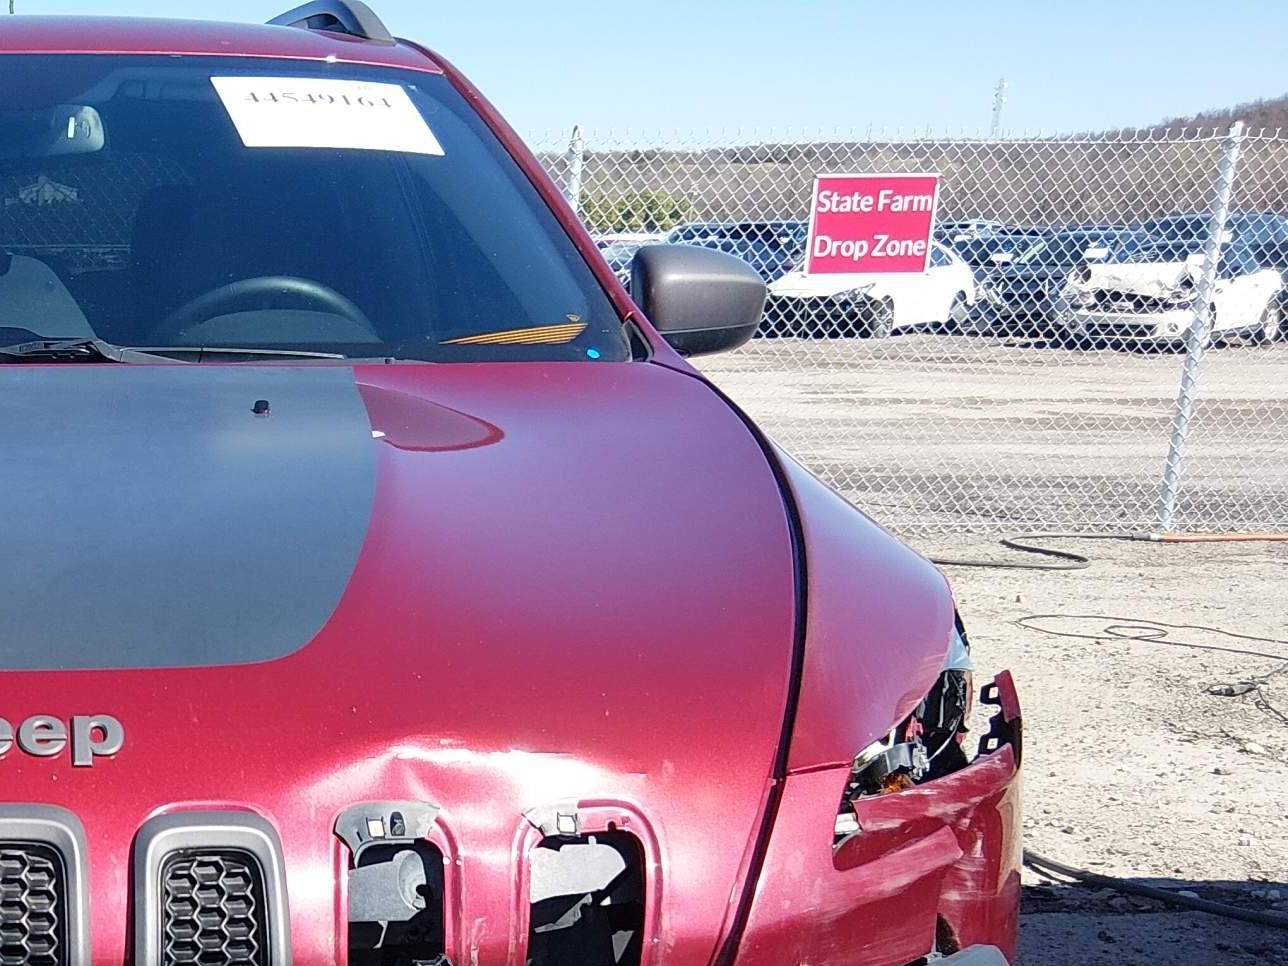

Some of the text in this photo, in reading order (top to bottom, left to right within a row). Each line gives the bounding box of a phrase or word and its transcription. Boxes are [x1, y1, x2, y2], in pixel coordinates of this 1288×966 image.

[817, 189, 933, 213] State Farm
[813, 234, 927, 261] Drop Zone
